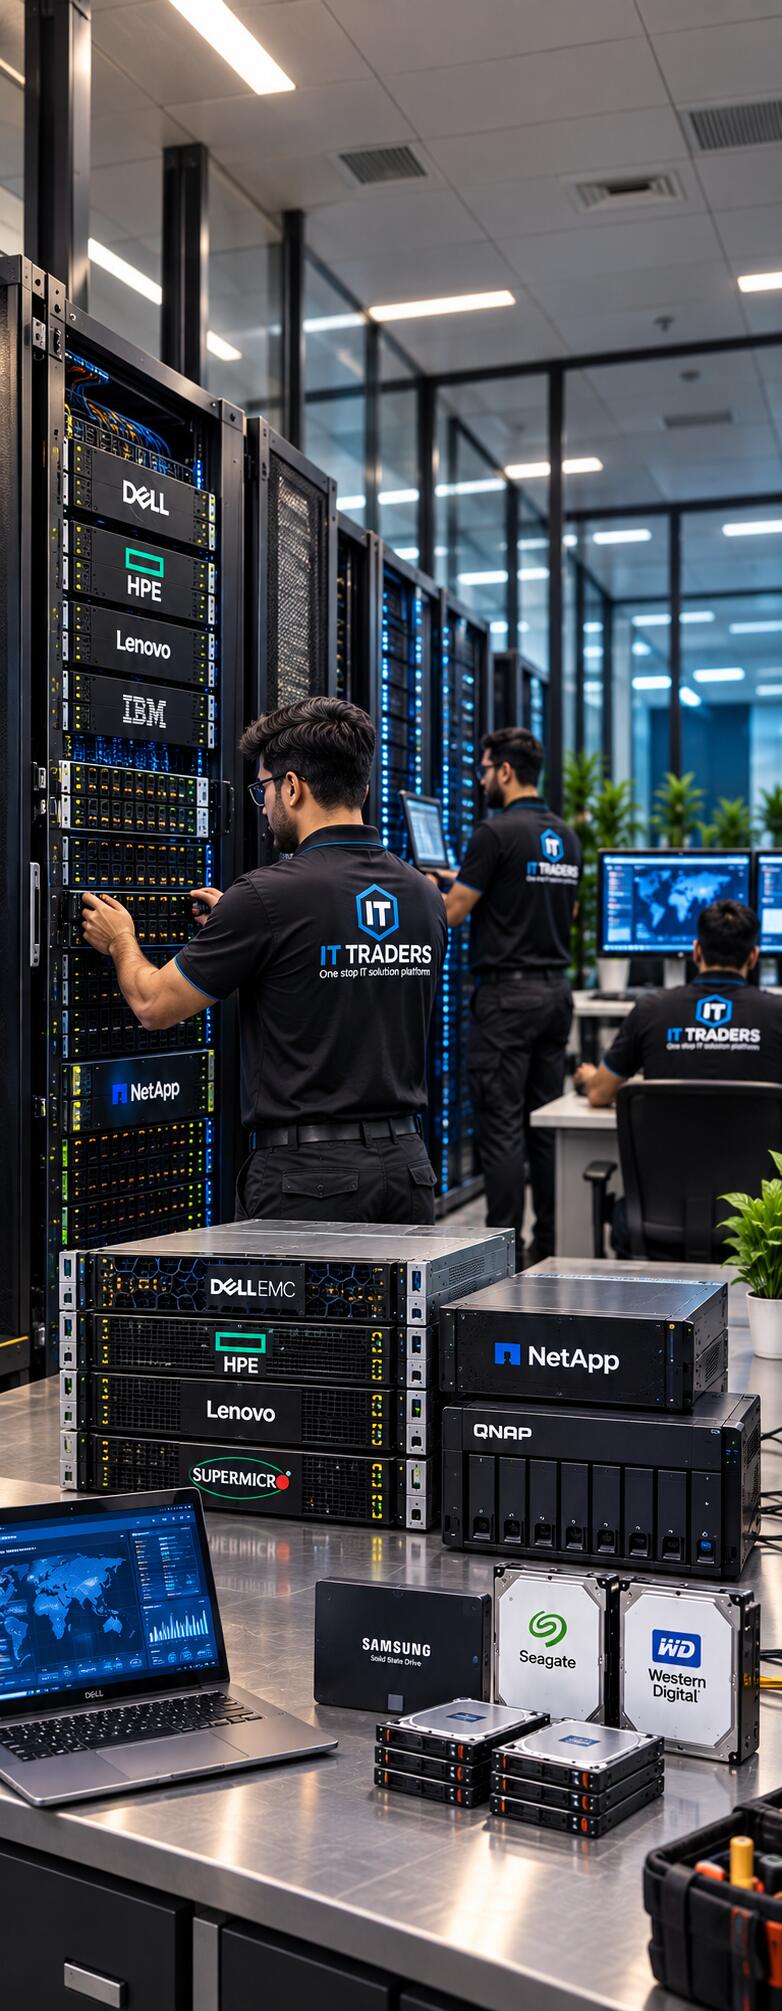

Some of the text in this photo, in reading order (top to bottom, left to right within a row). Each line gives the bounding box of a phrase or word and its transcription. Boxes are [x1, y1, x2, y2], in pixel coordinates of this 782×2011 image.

[122, 479, 170, 517] DELL
[127, 574, 162, 602] HPE
[116, 629, 171, 660] Lenovo
[122, 694, 167, 728] IBM
[365, 900, 391, 927] IT
[320, 944, 432, 966] IT TRADERS
[319, 966, 431, 979] One stop IT solution platform
[703, 1003, 726, 1020] IT
[667, 1027, 761, 1042] IT TRADERS
[130, 1081, 180, 1102] NetApp
[223, 1356, 259, 1374] HPE
[528, 1346, 620, 1374] NetApp
[206, 1400, 276, 1423] Lenovo
[473, 1424, 532, 1440] QNAP
[362, 1637, 431, 1657] SAMSUNG
[658, 1637, 696, 1659] WD
[519, 1650, 577, 1669] Seagate
[648, 1668, 706, 1689] Western
[84, 1689, 104, 1699] DELL
[653, 1684, 699, 1703] Digital
